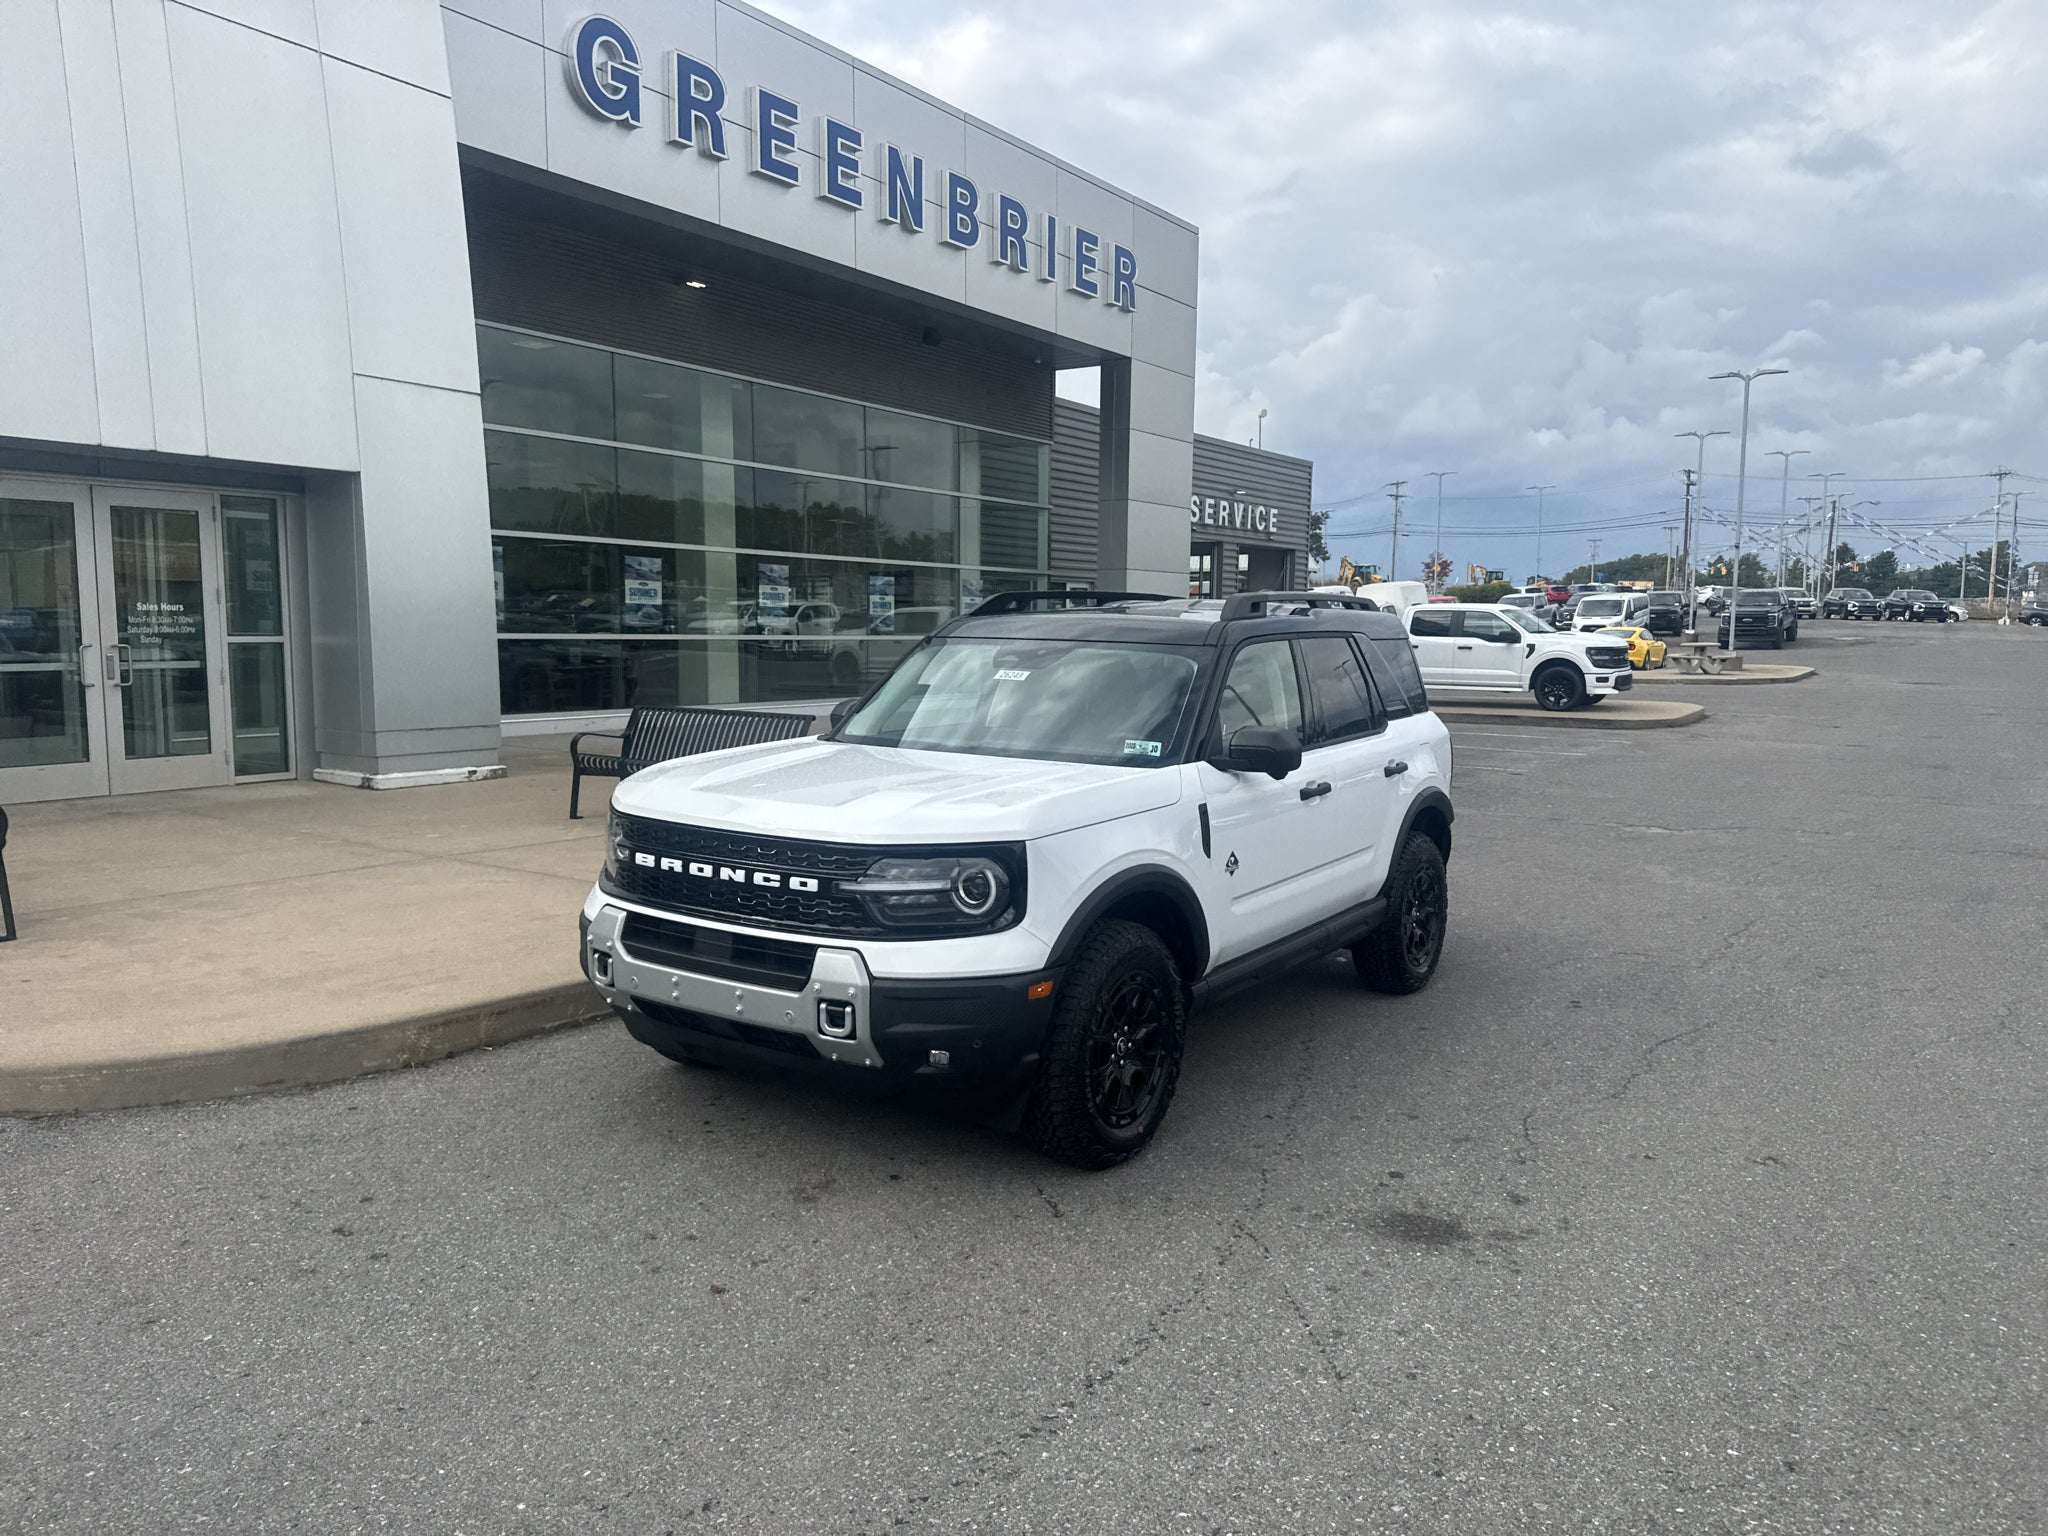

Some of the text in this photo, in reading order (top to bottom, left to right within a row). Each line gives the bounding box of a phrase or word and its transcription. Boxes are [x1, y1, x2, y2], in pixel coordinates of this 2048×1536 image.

[567, 13, 1137, 312] GREENBRIER
[1191, 495, 1278, 532] SERVICE
[136, 602, 184, 611] Sales Hours
[140, 635, 162, 644] Sunday
[635, 852, 819, 892] BRONCO
